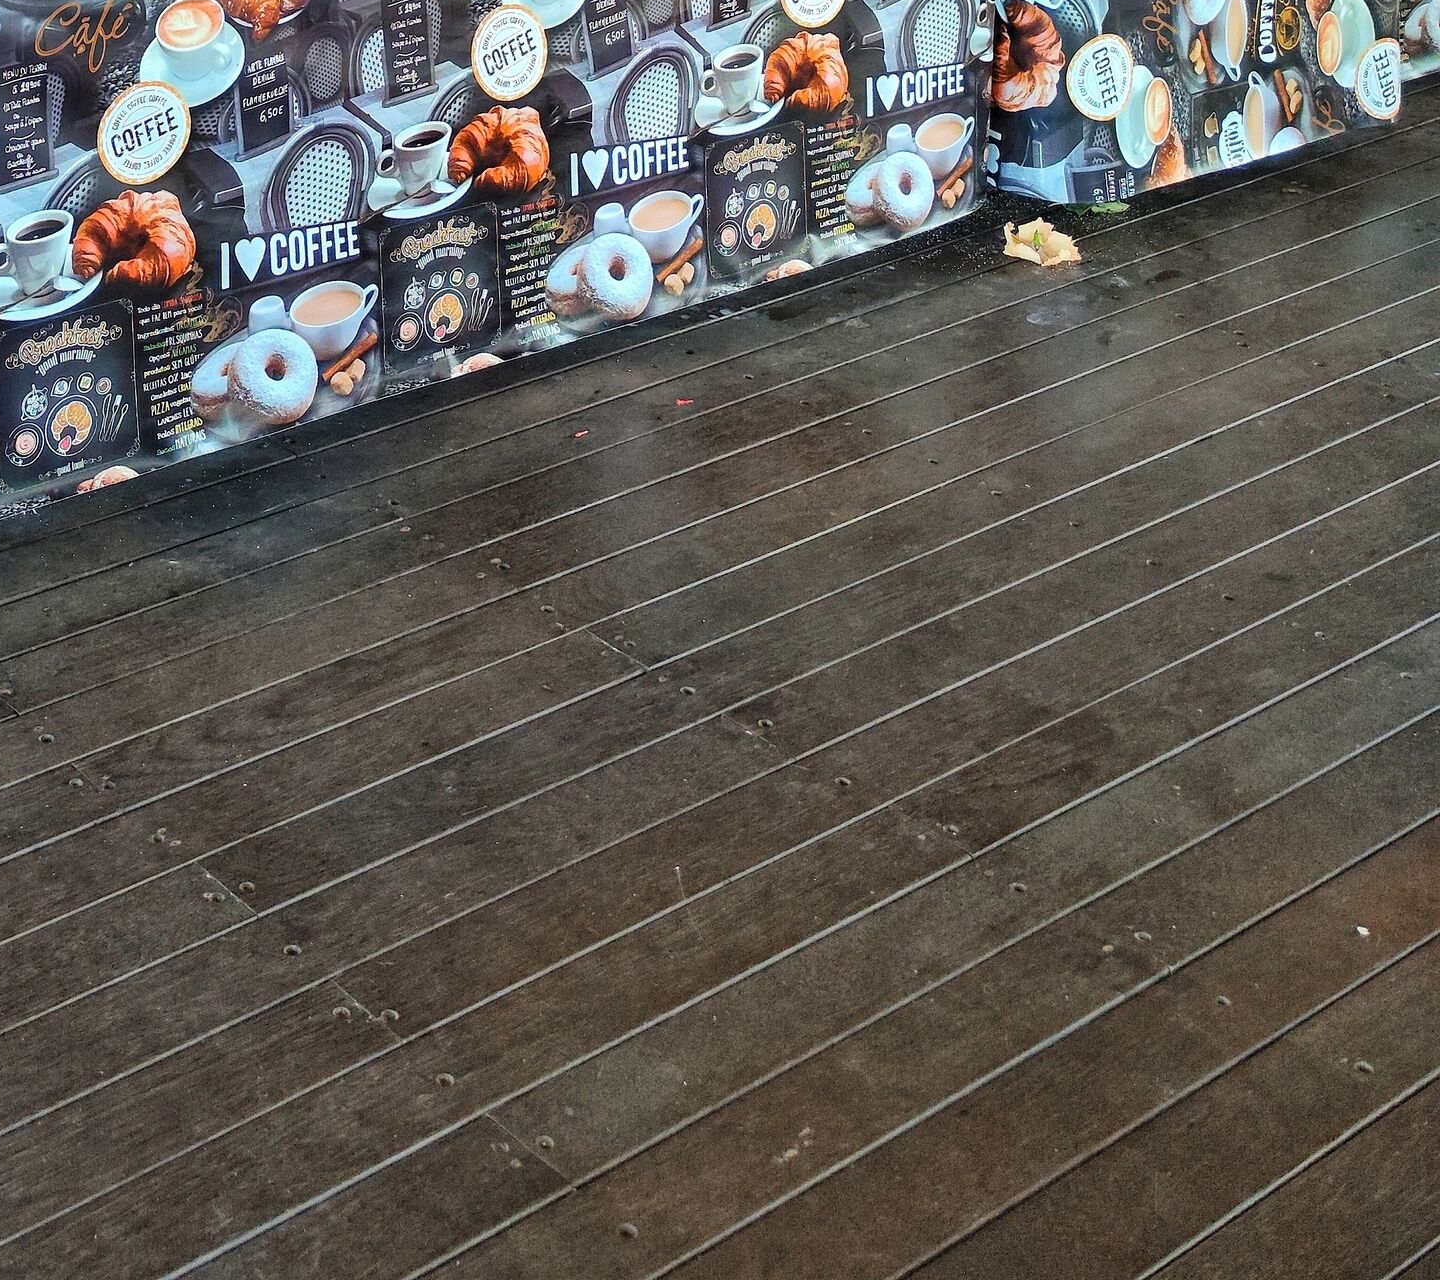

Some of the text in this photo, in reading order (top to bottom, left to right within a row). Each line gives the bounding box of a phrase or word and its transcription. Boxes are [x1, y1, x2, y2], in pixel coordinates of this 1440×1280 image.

[481, 28, 538, 77] COFFEE
[1092, 47, 1118, 109] COFFEE
[1373, 48, 1397, 109] COFFEE
[864, 63, 965, 118] I COFFEE
[110, 107, 179, 158] COFFEE
[570, 136, 689, 197] I COFFEE
[220, 219, 360, 290] I COFFEE
[18, 319, 109, 365] Breakfast
[59, 347, 94, 363] morning
